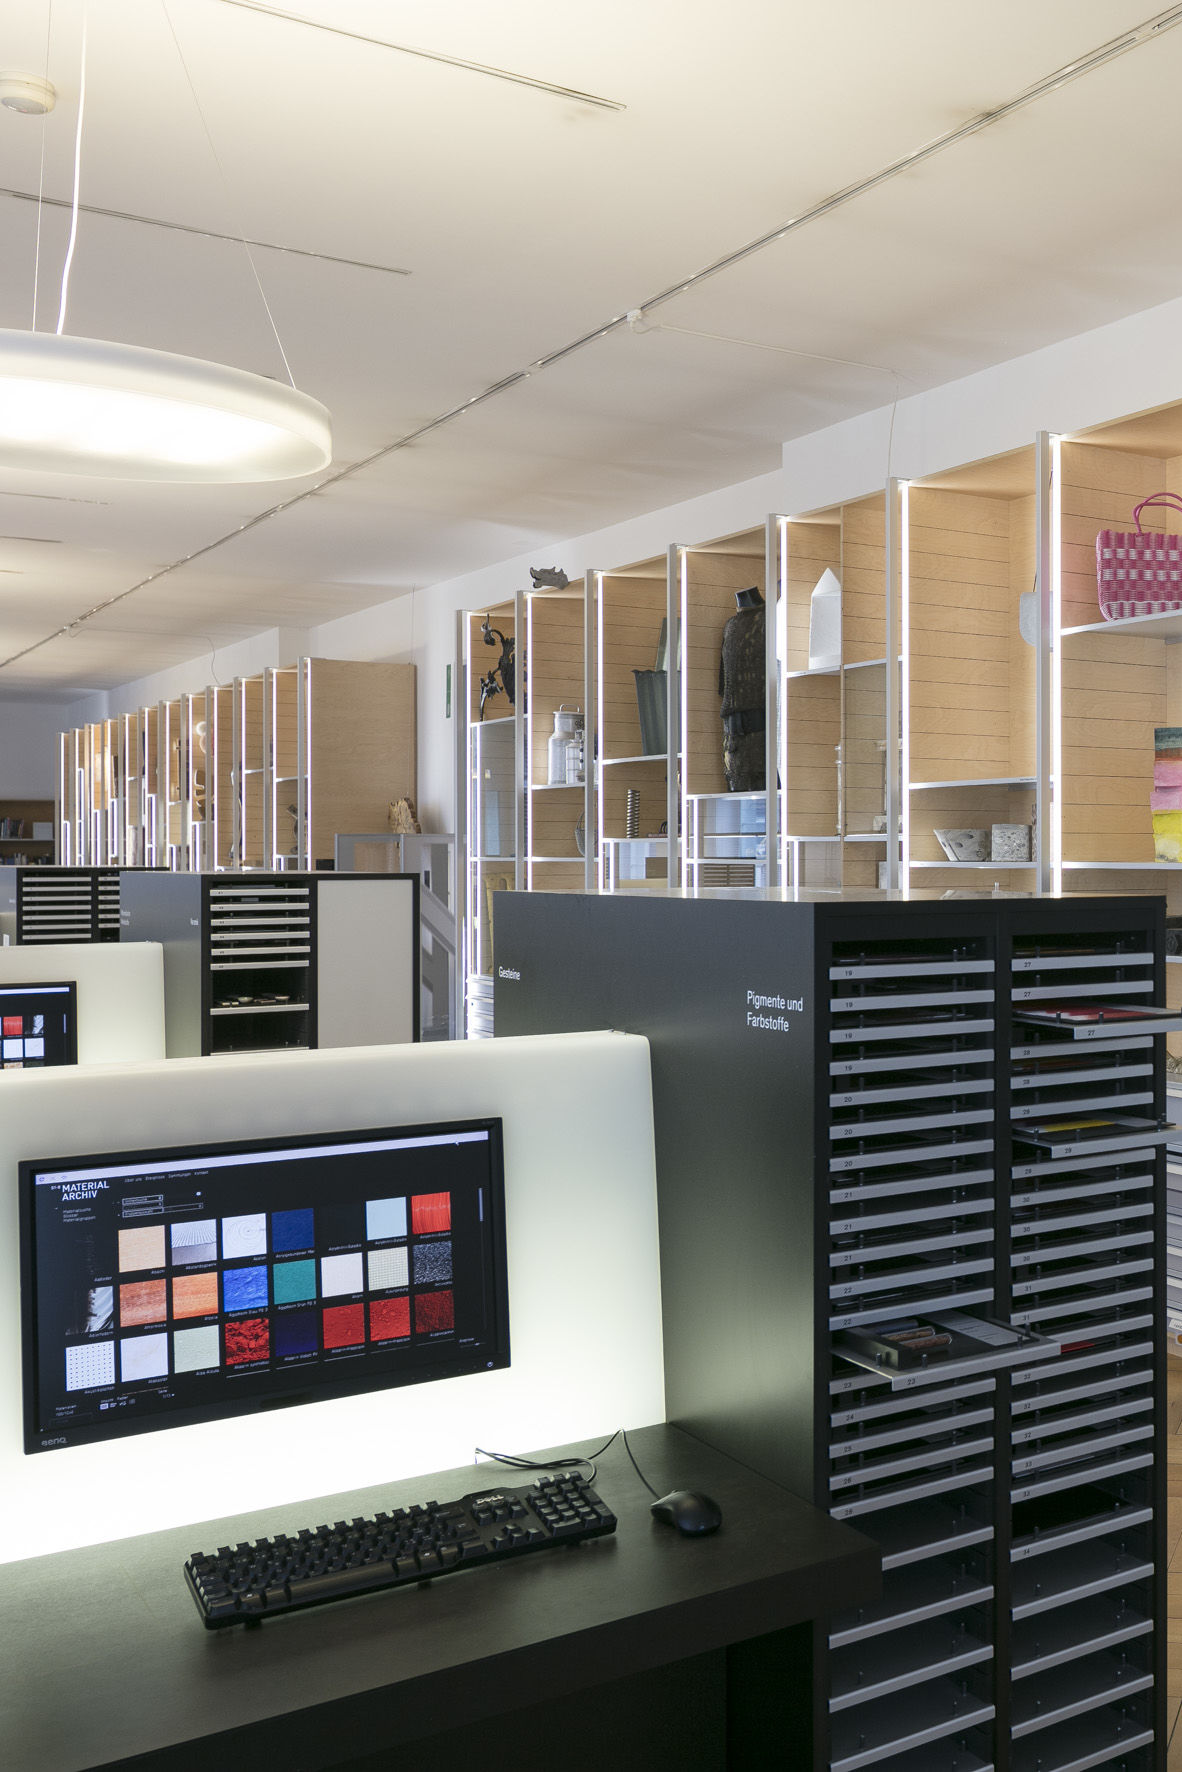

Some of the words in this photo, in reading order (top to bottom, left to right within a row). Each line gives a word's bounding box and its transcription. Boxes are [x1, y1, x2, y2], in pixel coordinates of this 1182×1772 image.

[498, 965, 521, 981] Gesteine
[747, 990, 785, 1011] Pigmente
[787, 997, 803, 1012] und
[747, 1012, 789, 1033] Farbstoffe
[62, 1180, 110, 1193] MATERIAL
[61, 1190, 98, 1201] ARCHIV
